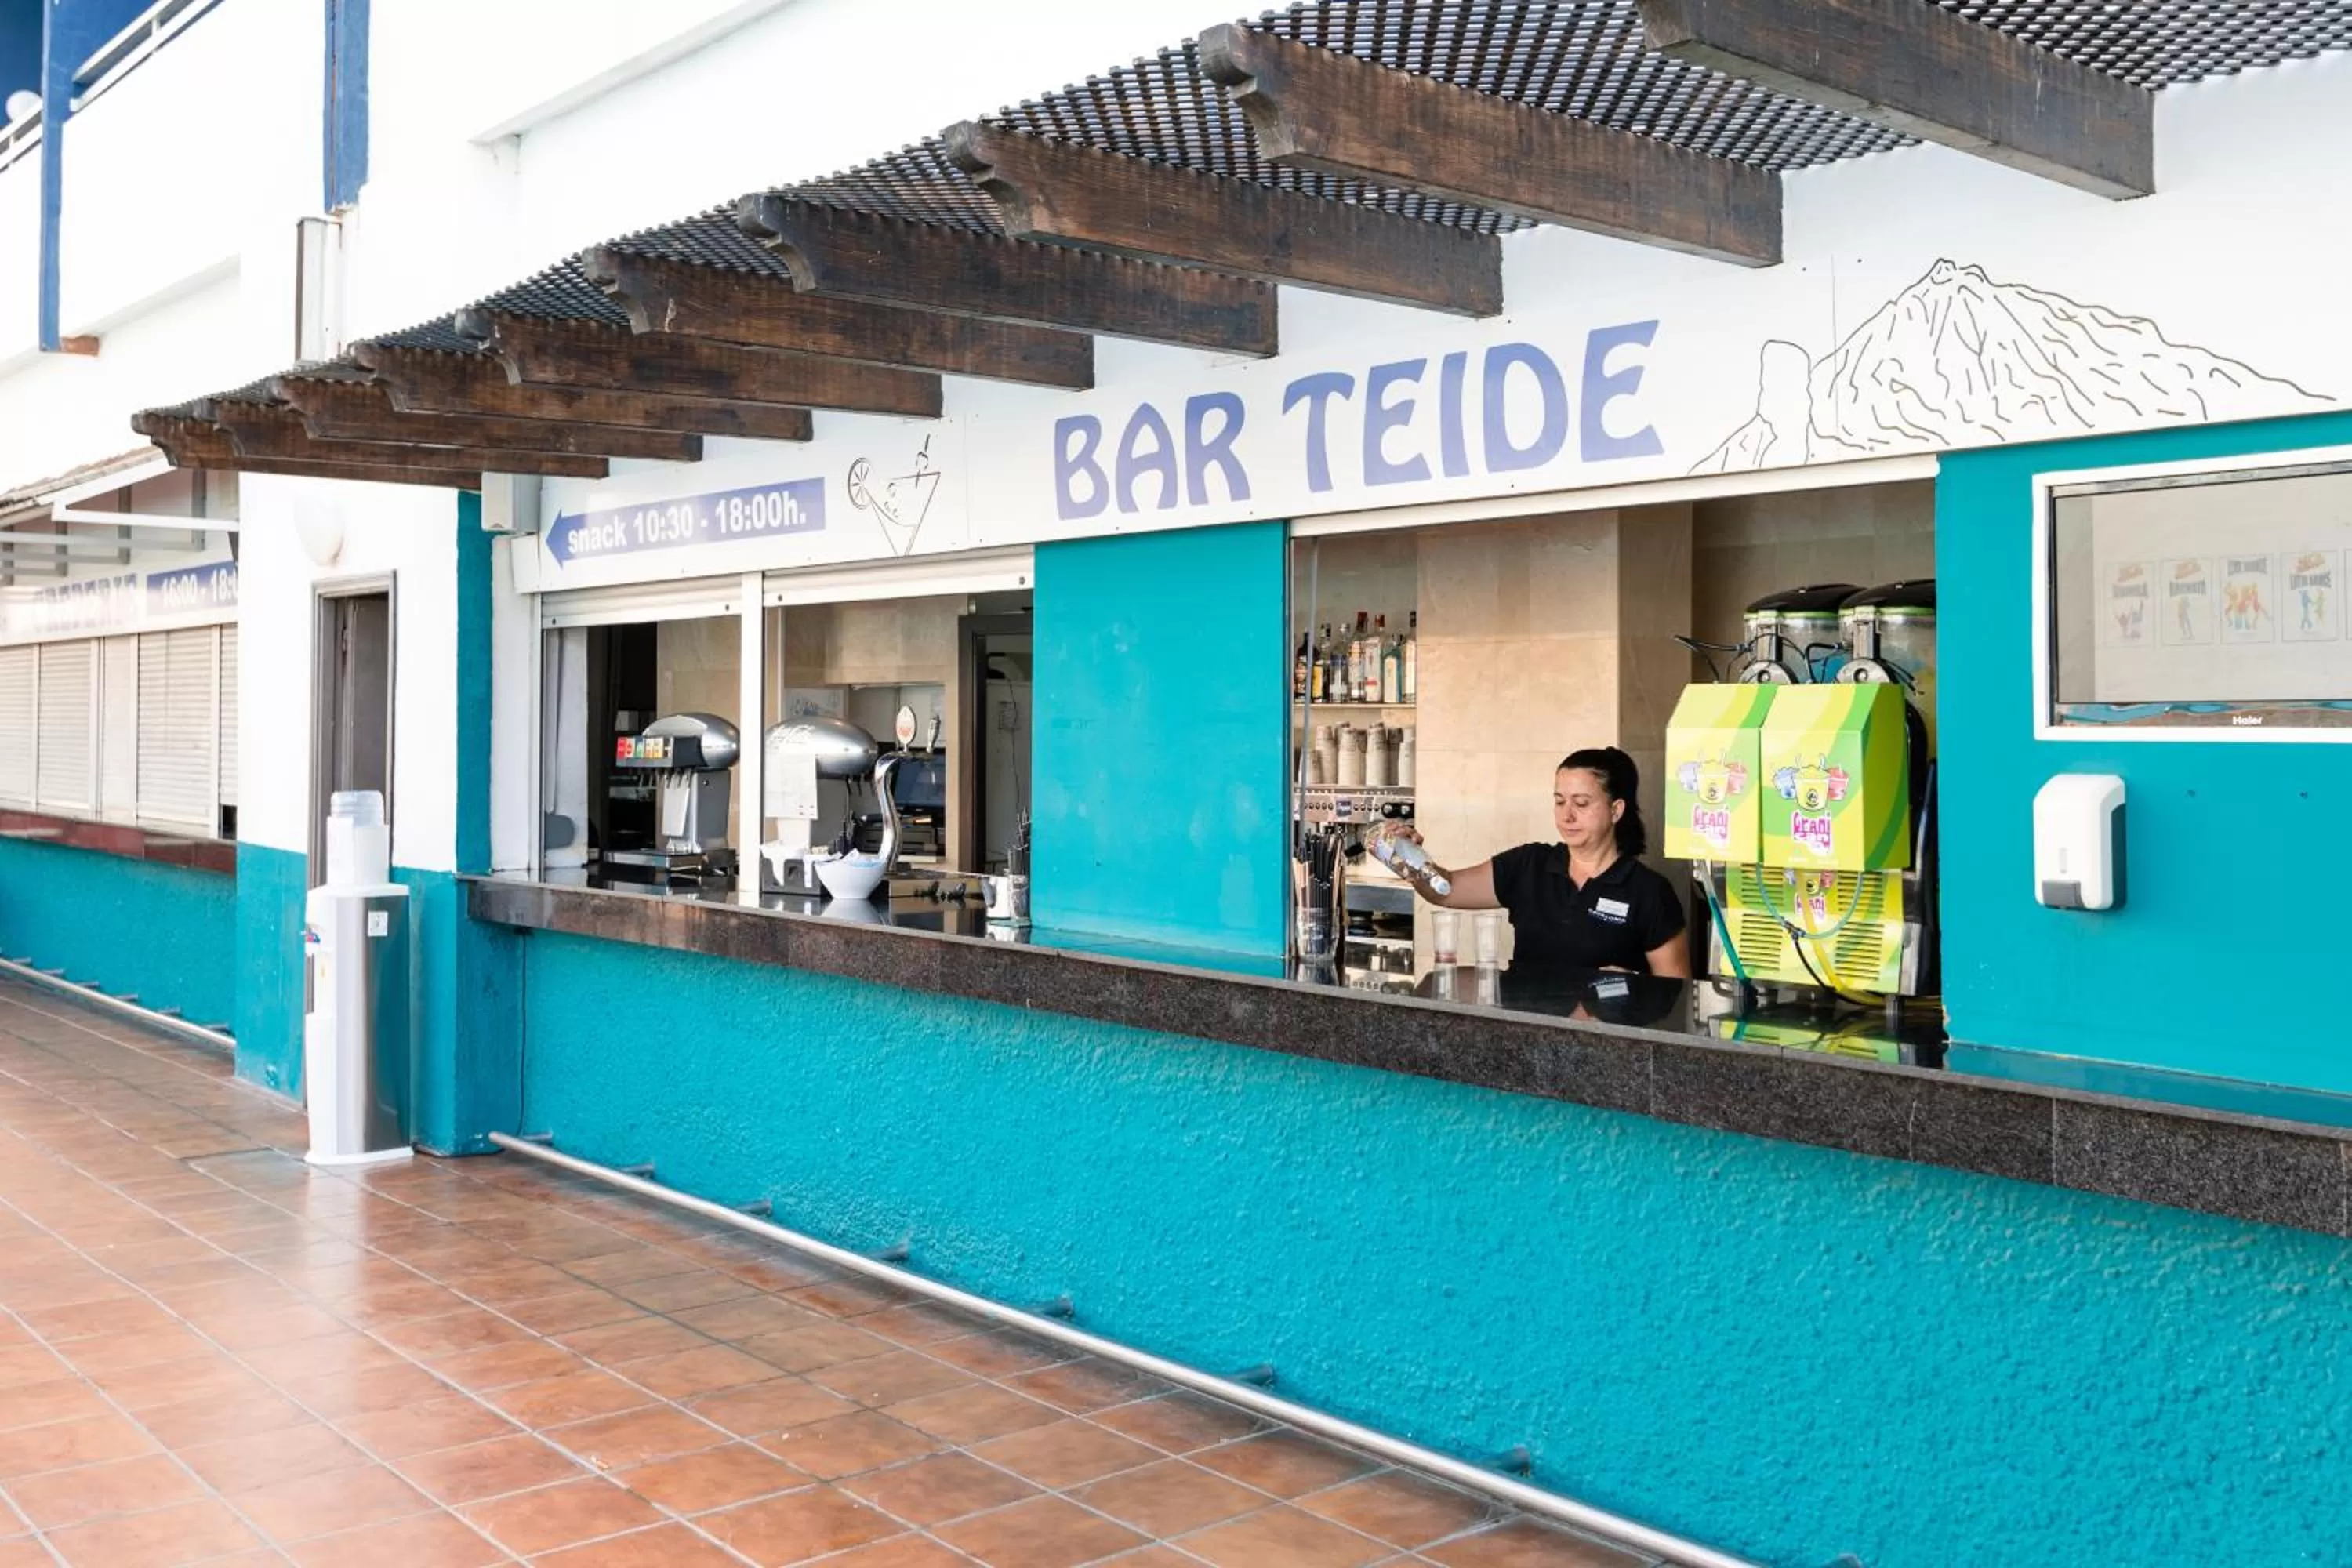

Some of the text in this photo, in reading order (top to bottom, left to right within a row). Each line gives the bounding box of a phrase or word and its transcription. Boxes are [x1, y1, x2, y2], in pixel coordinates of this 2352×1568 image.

[1053, 319, 1665, 521] BAR TEIDE
[568, 518, 628, 554] snack
[633, 504, 693, 544] 10:30
[715, 491, 807, 534] 18:00h.
[2232, 714, 2263, 725] Haier
